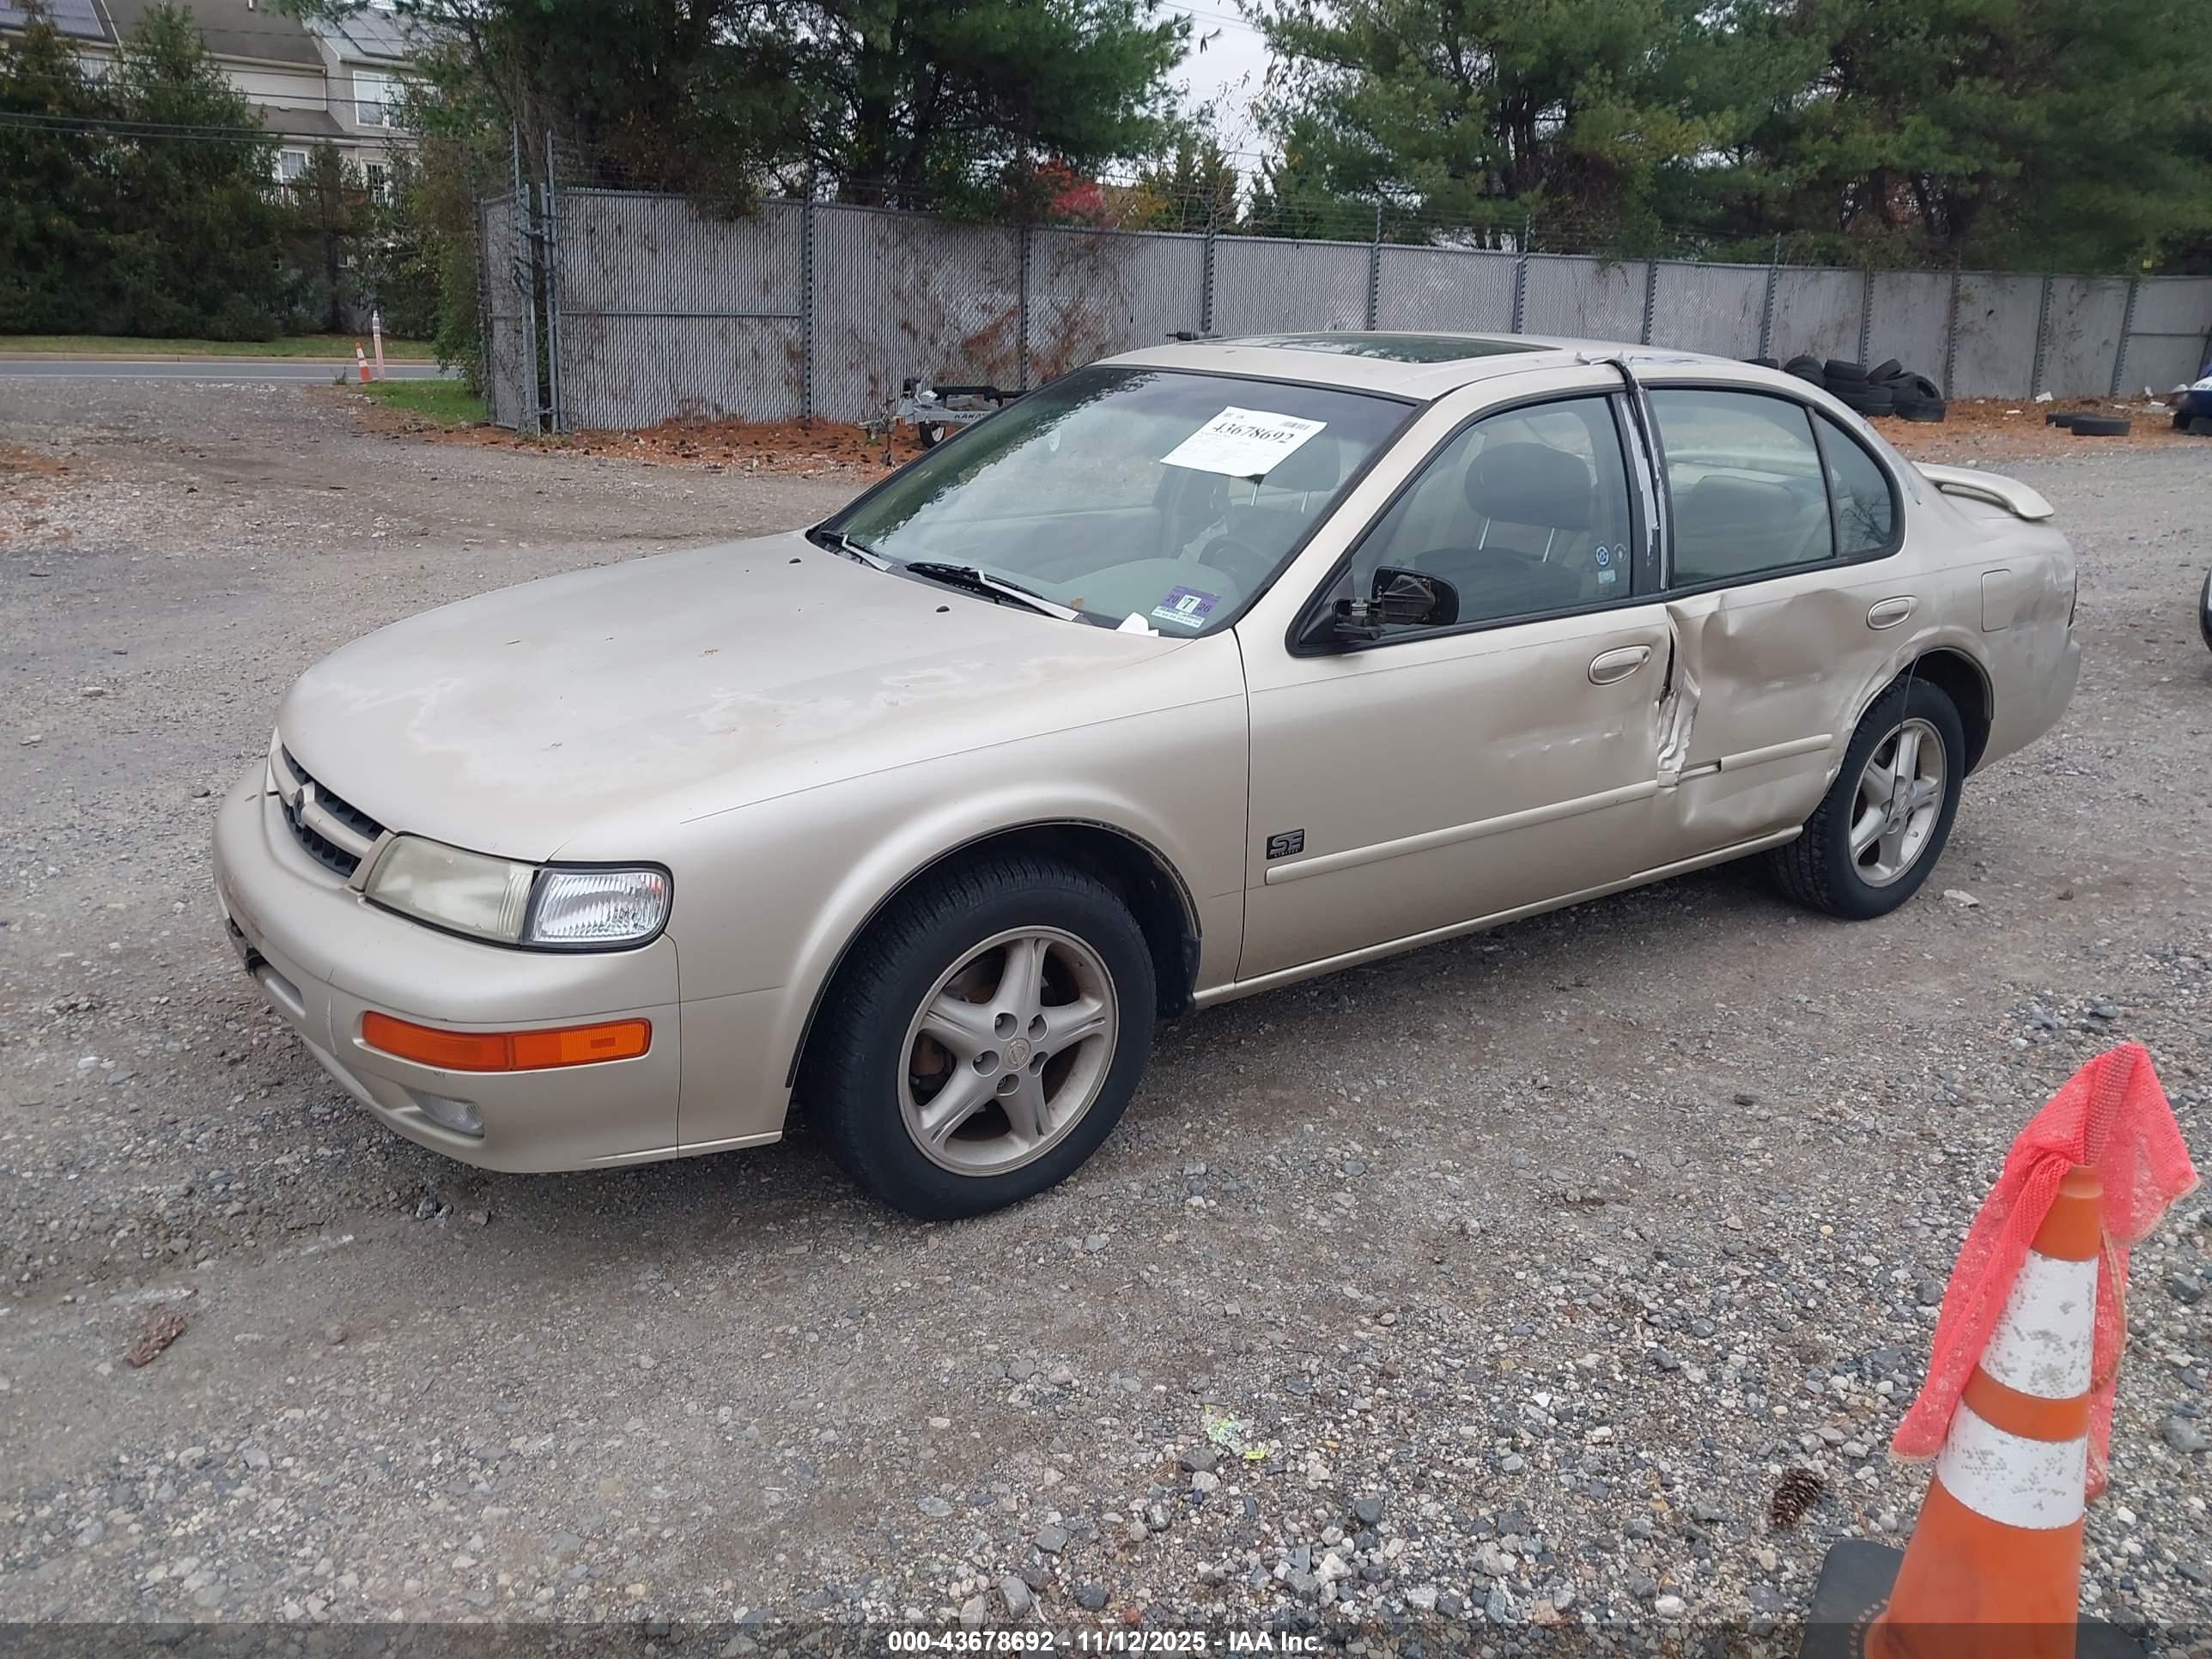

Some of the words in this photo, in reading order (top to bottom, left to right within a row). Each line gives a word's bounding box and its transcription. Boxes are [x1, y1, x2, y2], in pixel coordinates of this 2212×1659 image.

[1212, 421, 1295, 444] 43678692
[1166, 594, 1180, 604] 20
[1182, 597, 1194, 610] 7
[1197, 603, 1211, 612] 26
[1270, 830, 1303, 855] SE
